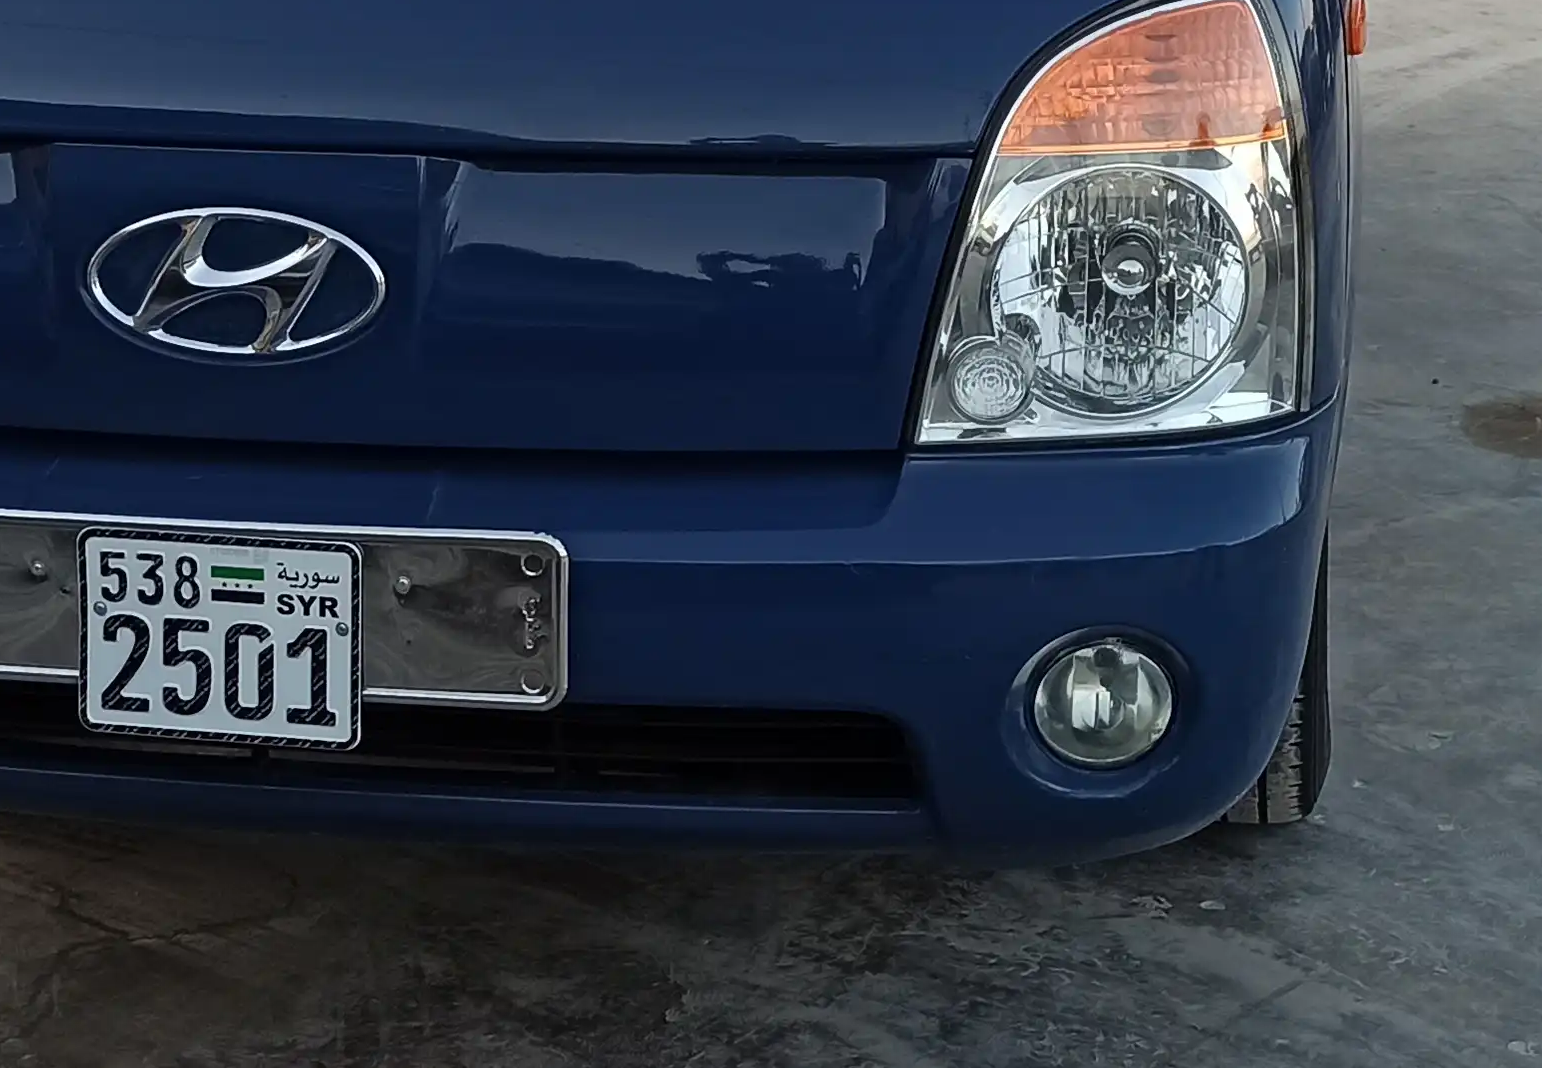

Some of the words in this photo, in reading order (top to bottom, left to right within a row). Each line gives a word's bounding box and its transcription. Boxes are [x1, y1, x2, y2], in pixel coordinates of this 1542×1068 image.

[99, 550, 201, 610] 538
[275, 561, 341, 590] سورية
[275, 593, 340, 619] SYR
[100, 613, 337, 727] 2501
